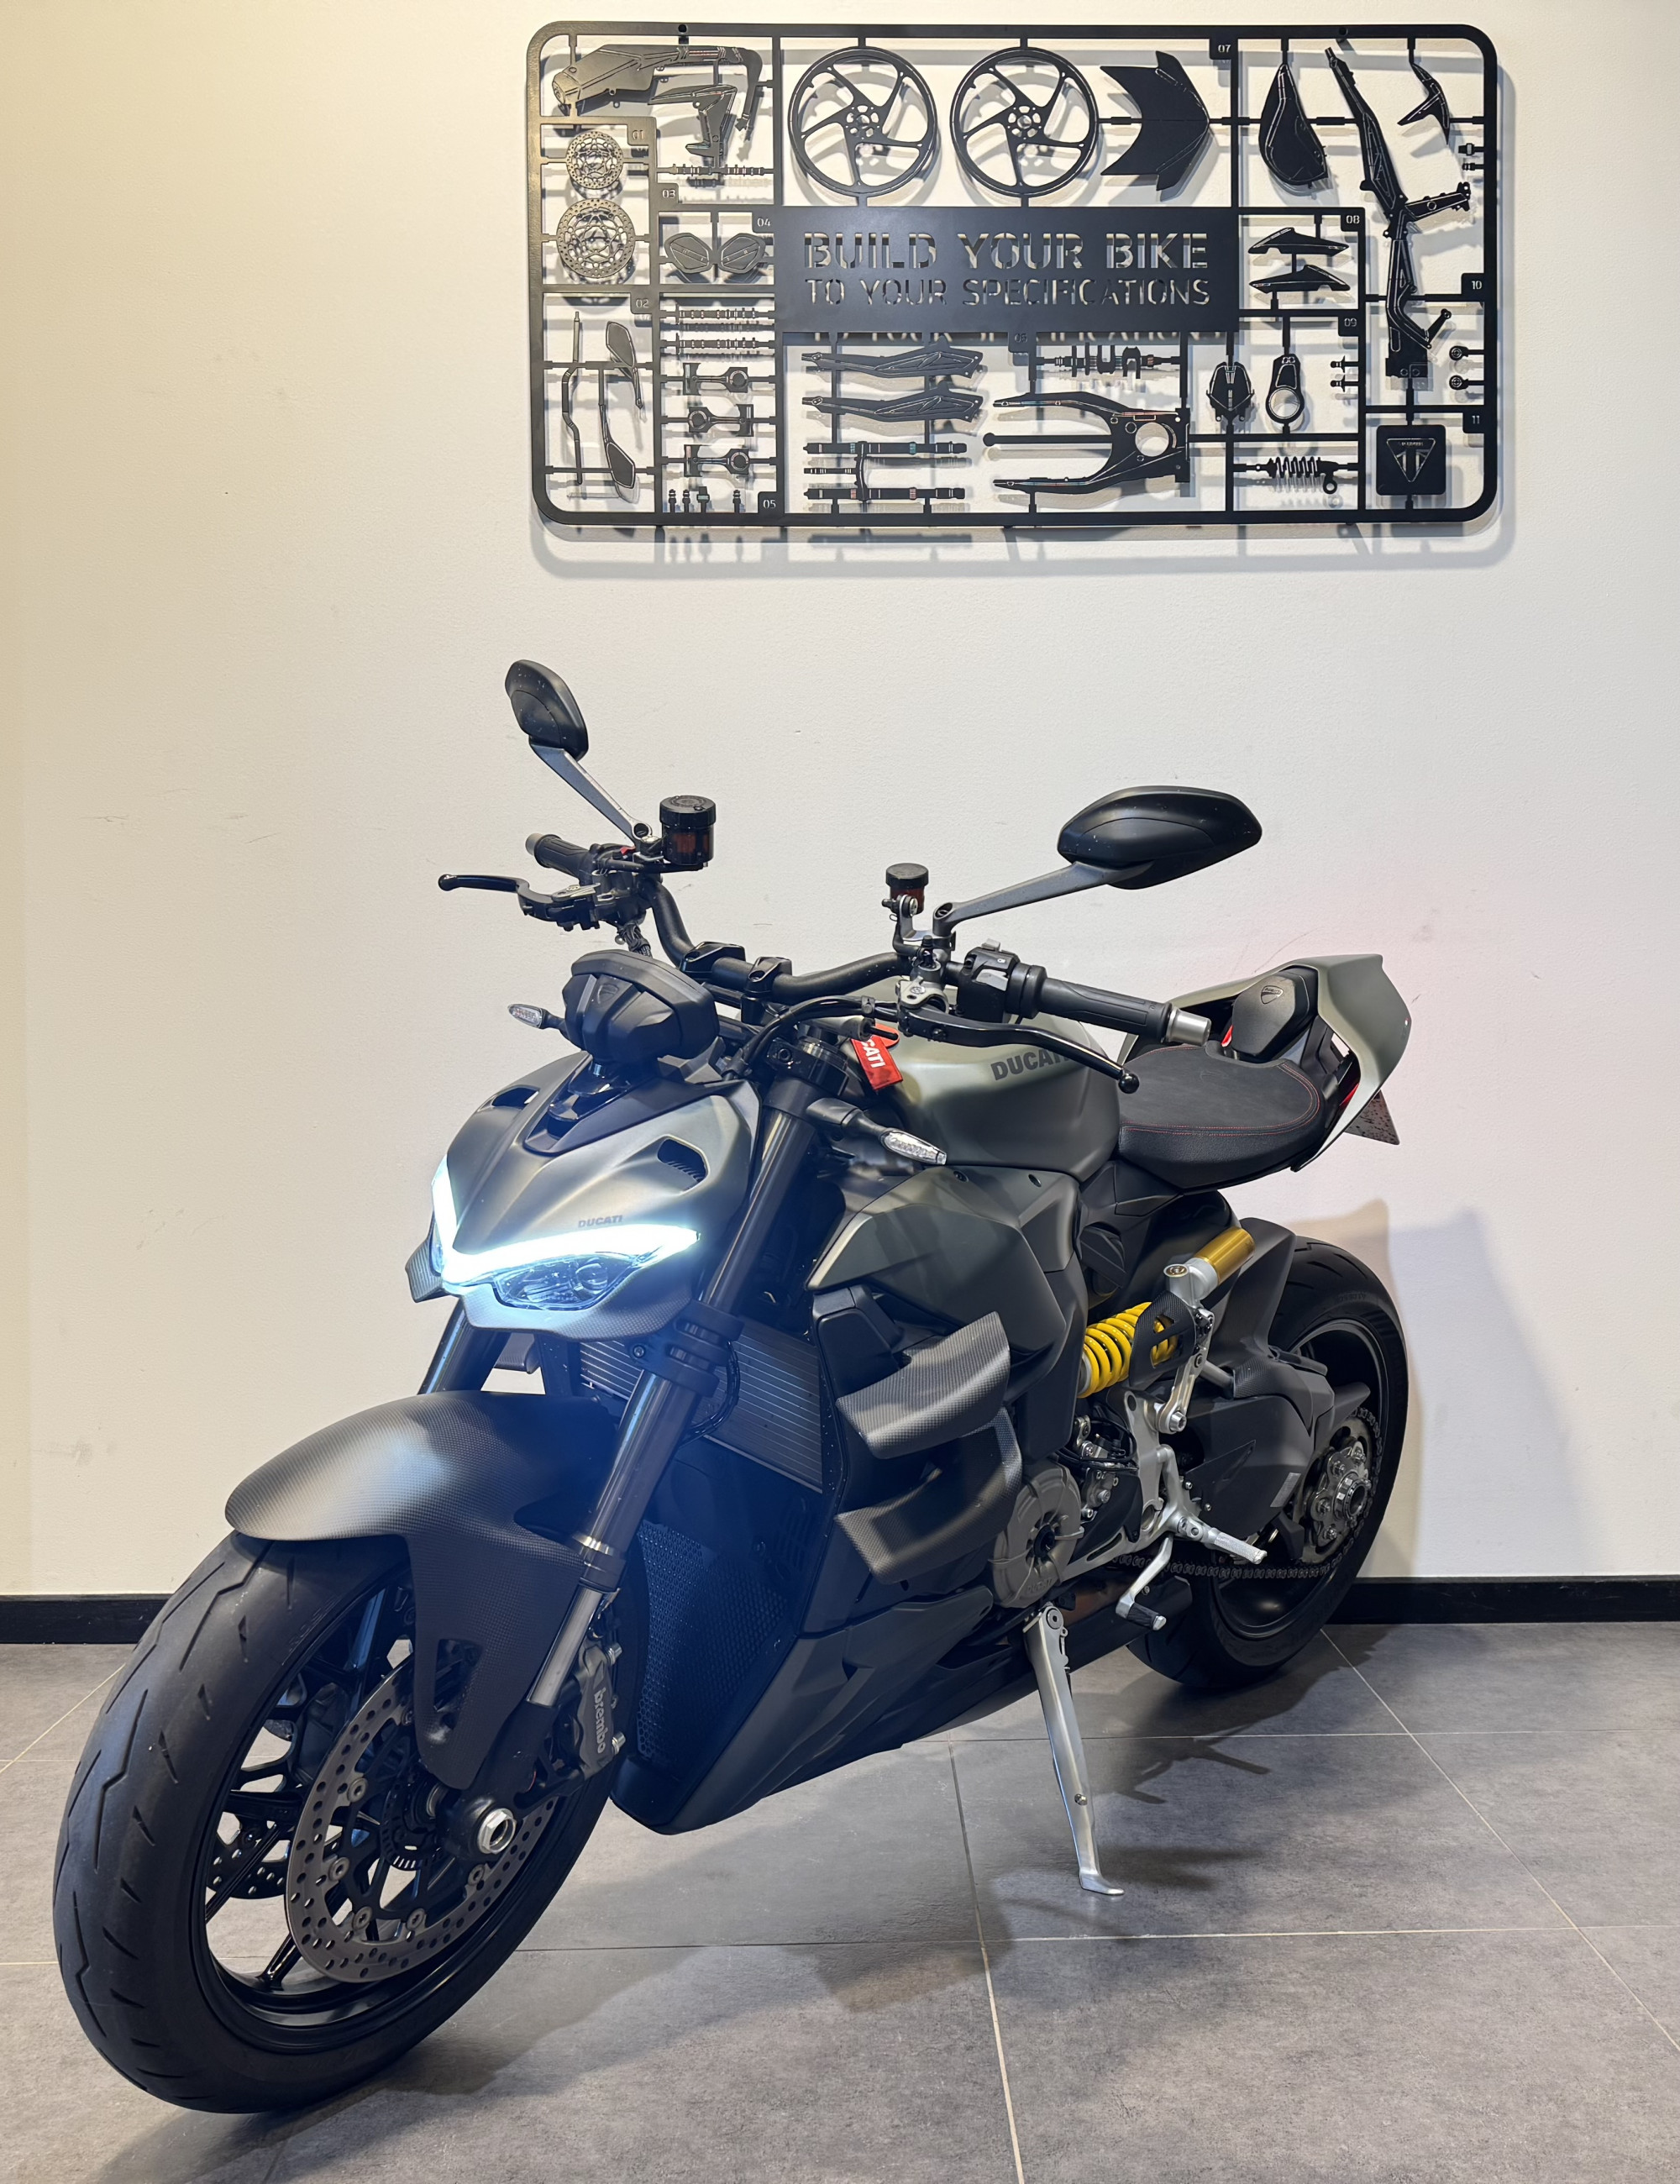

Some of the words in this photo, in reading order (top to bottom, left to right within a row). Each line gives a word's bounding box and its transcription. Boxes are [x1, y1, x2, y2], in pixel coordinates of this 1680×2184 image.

[1217, 44, 1231, 53] 07
[632, 129, 644, 140] 01
[661, 189, 676, 199] 03
[757, 218, 771, 227] 04
[1346, 214, 1360, 224] 08
[804, 232, 938, 270] BUILD
[957, 232, 1084, 270] YOUR
[1105, 232, 1209, 270] BIKE
[1471, 280, 1483, 290] 10
[805, 279, 846, 306] TO
[859, 279, 948, 306] YOUR
[962, 279, 1210, 306] SPECIFICATIONS
[636, 298, 649, 308] 02
[1344, 318, 1357, 328] 09
[1472, 415, 1480, 424] 11
[763, 499, 776, 509] 05
[577, 1215, 623, 1228] DUCATI
[594, 1687, 608, 1754] brembo
